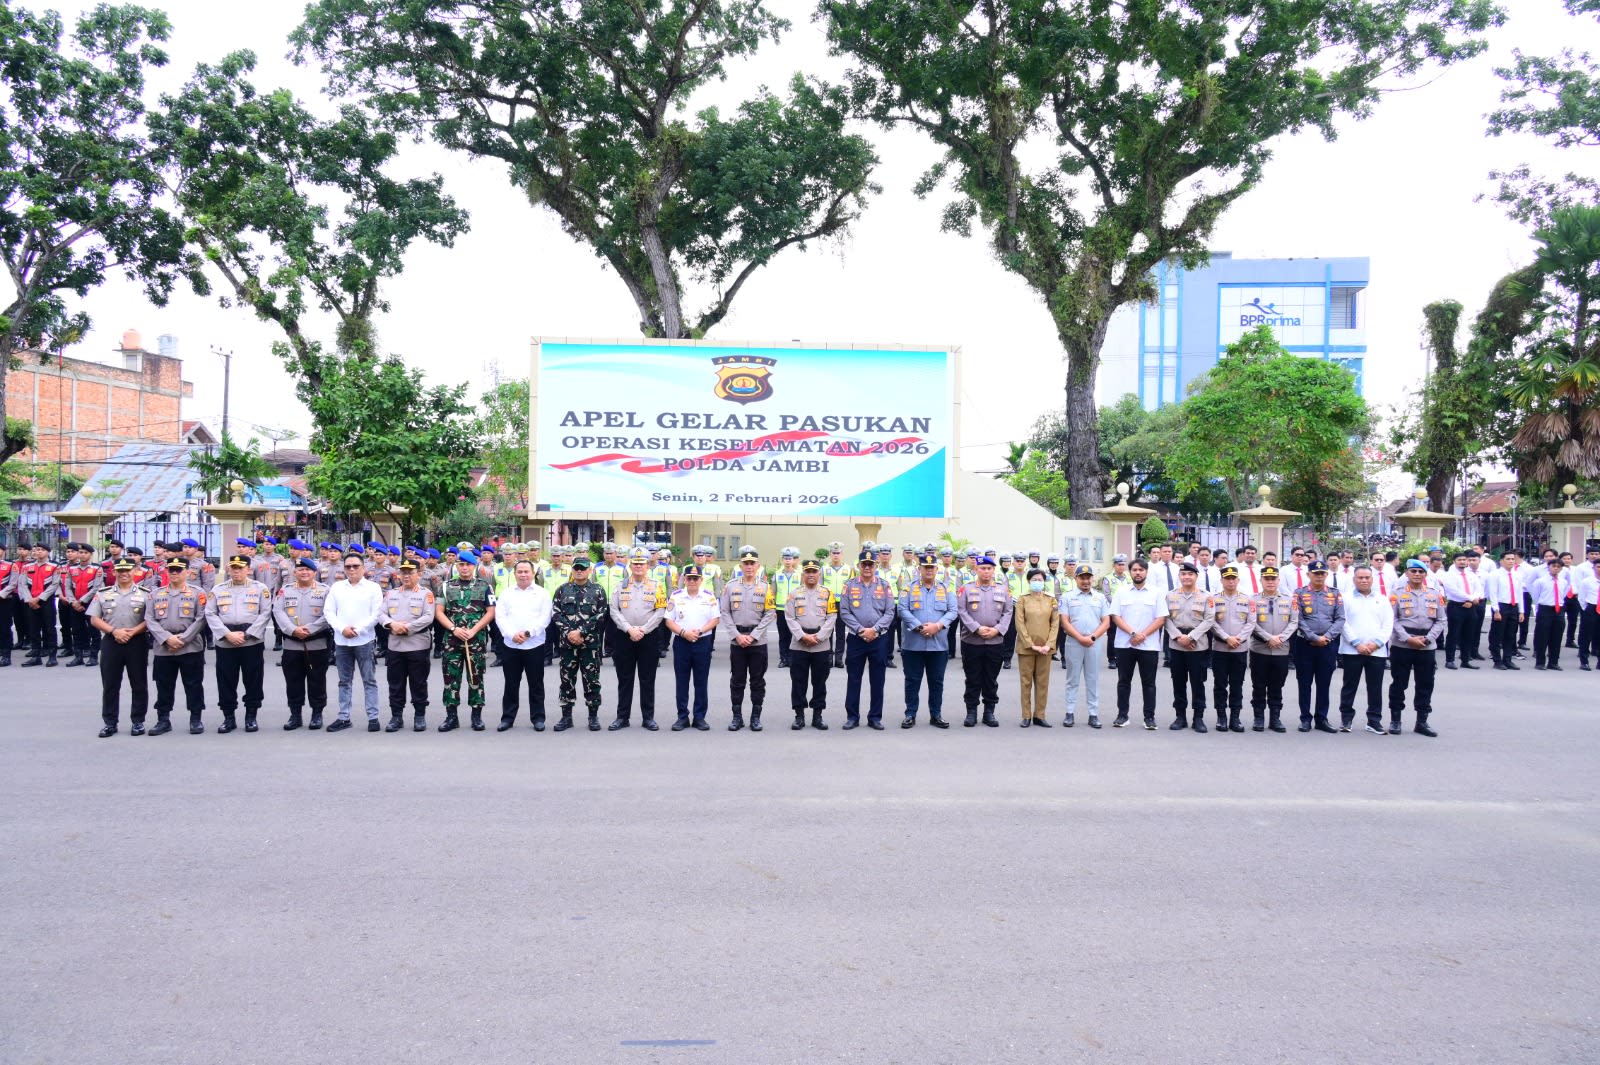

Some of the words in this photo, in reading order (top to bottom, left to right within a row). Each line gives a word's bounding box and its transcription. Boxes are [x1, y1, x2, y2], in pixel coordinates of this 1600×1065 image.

[717, 357, 772, 365] JAMBI
[559, 411, 644, 428] APEL
[656, 412, 767, 430] GELAR
[779, 415, 931, 433] PASUKAN
[561, 436, 670, 450] OPERASI
[679, 438, 861, 453] KESELAMATAN
[870, 441, 929, 455] 2026
[664, 457, 745, 472] POLDA
[752, 459, 830, 473] JAMBI
[652, 492, 703, 504] Senin,
[709, 493, 719, 503] 2
[726, 493, 792, 504] Februari
[798, 494, 839, 504] 2026
